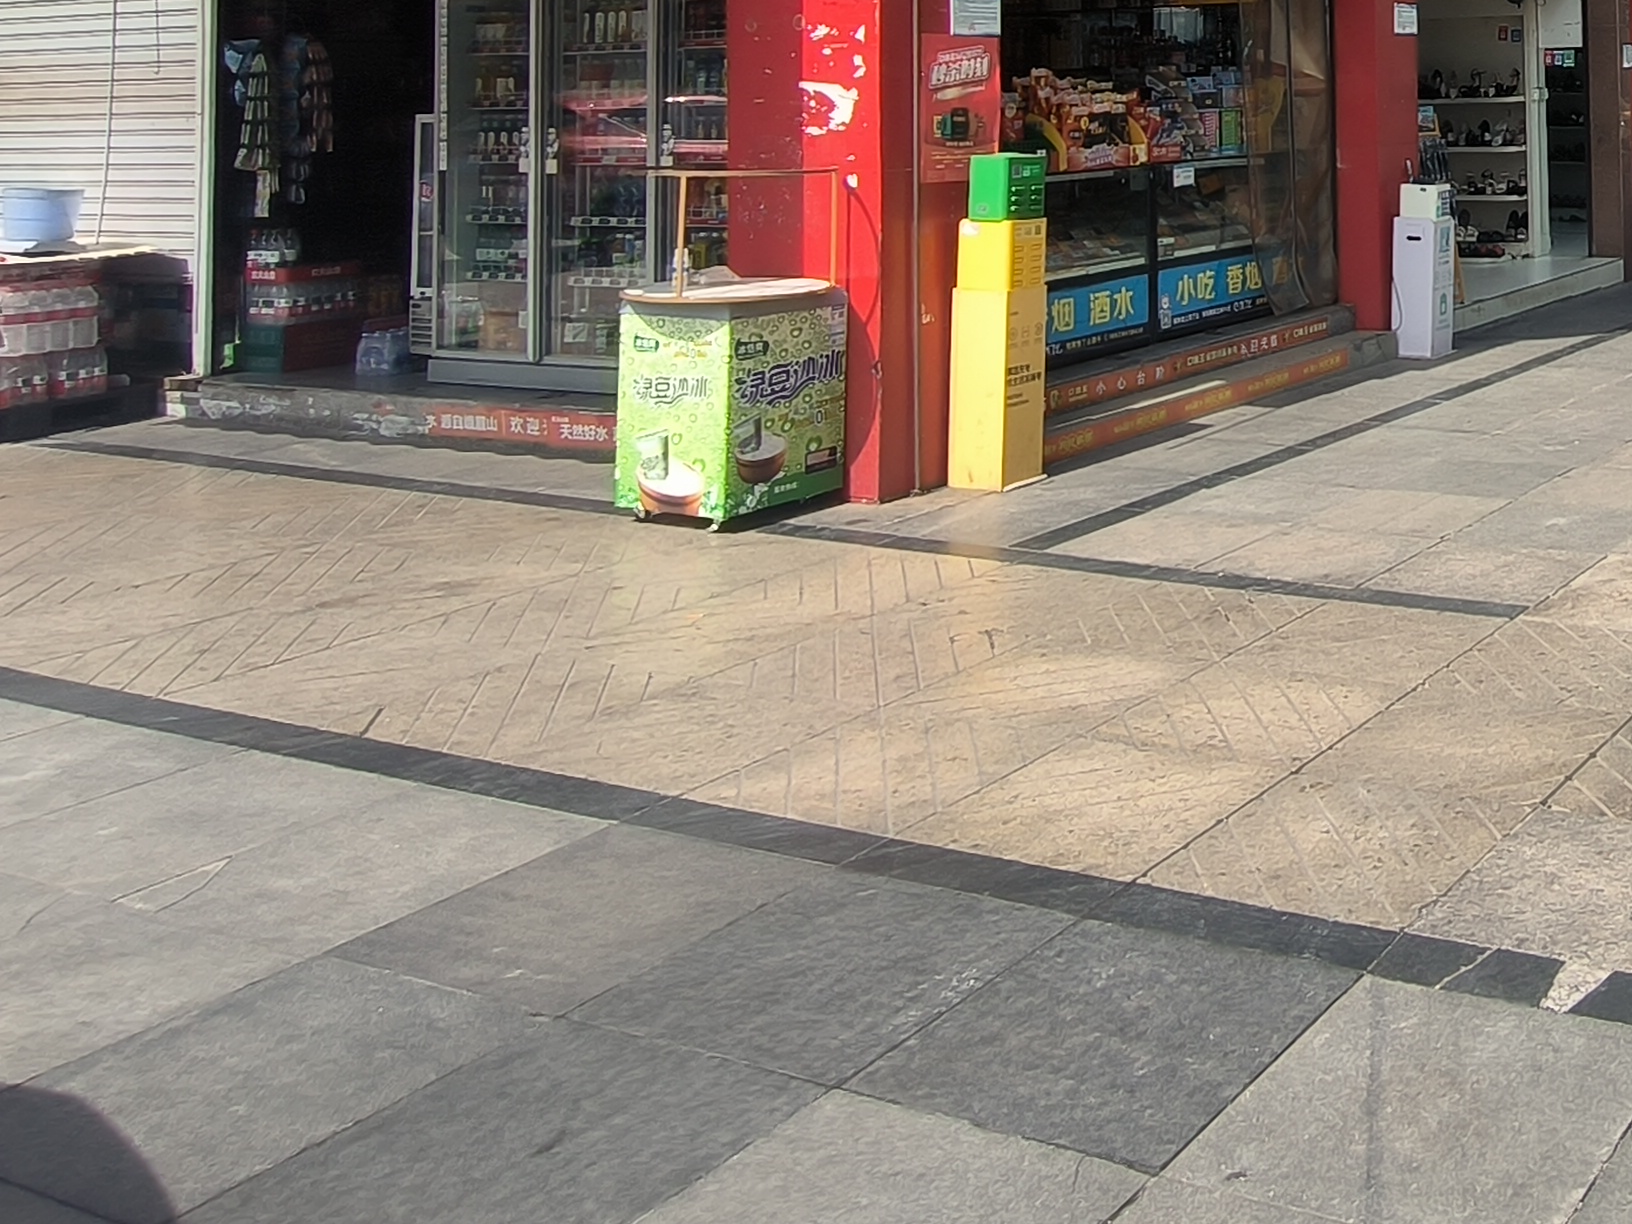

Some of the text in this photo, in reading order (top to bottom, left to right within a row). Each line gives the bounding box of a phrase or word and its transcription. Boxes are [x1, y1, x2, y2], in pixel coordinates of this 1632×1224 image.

[1176, 260, 1263, 306] 小吃 香烟
[1046, 297, 1074, 334] 烟
[1089, 285, 1134, 327] 酒水
[560, 423, 610, 442] 天然好水
